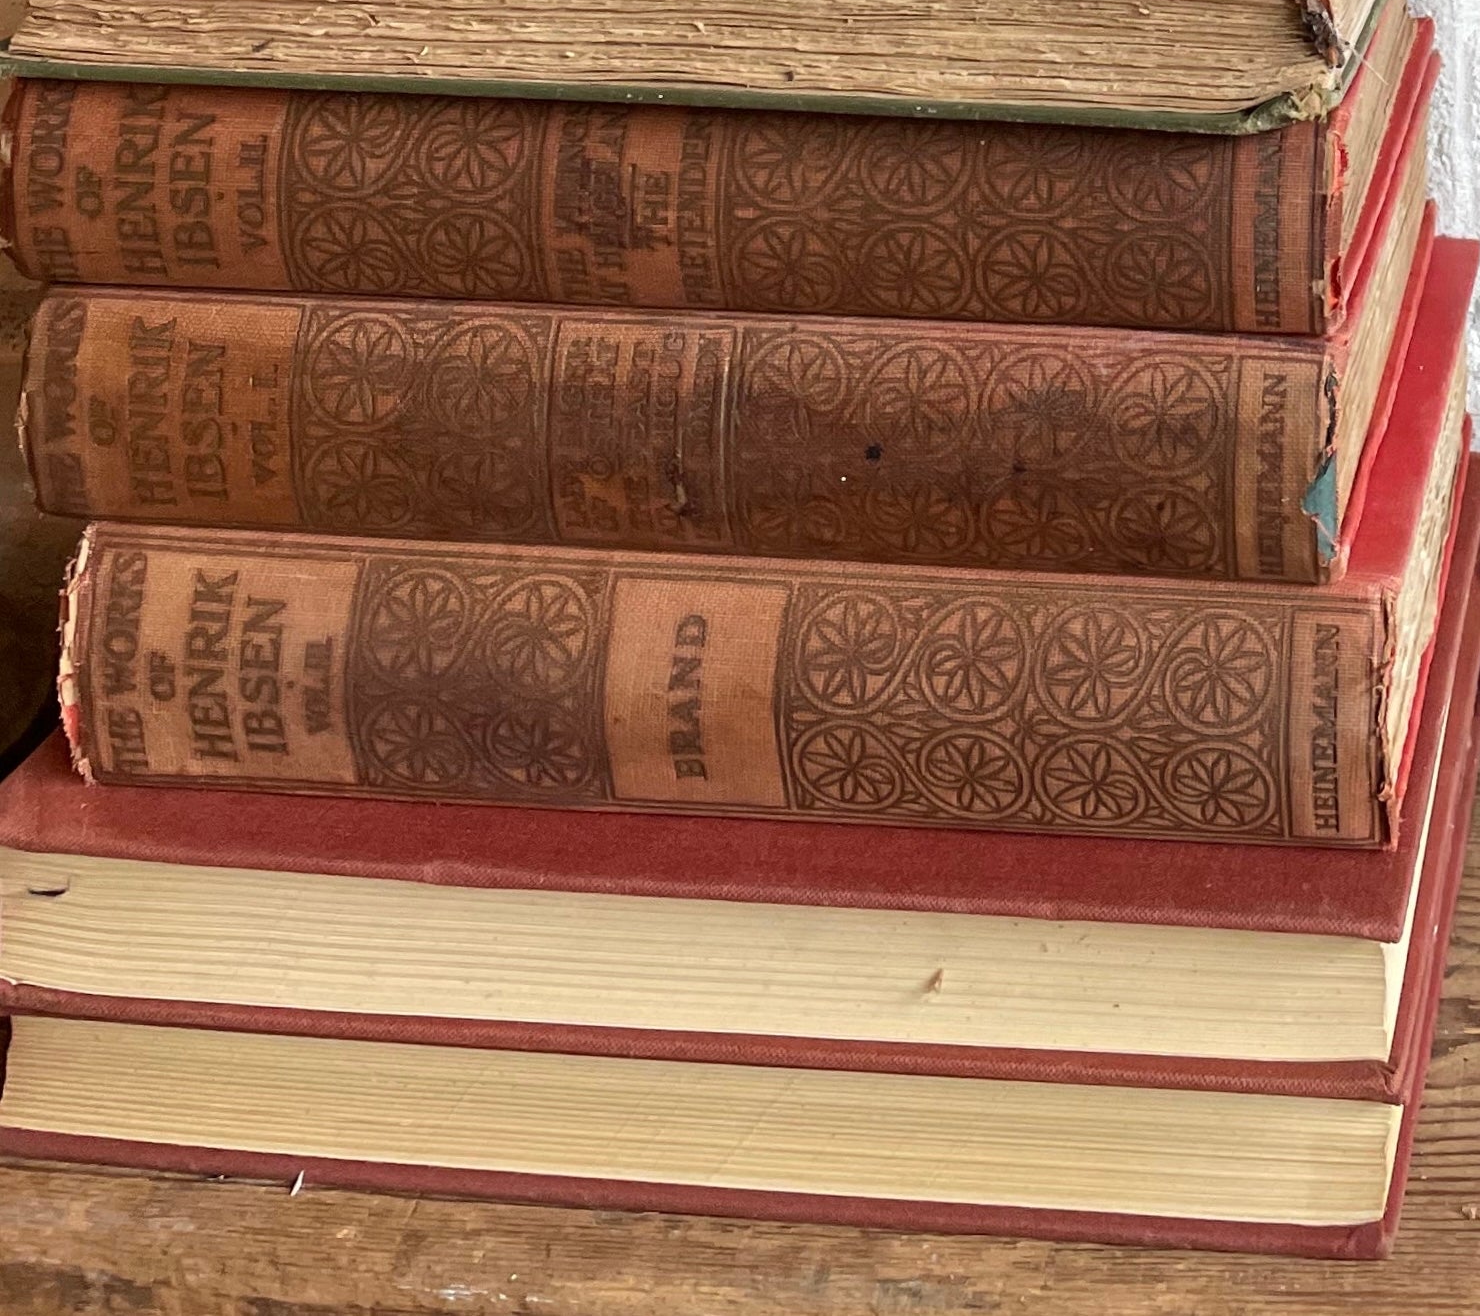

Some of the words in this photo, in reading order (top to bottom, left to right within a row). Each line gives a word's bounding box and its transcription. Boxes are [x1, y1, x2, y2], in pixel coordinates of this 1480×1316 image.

[76, 165, 104, 219] OF
[114, 83, 168, 278] HENRIK
[168, 110, 221, 270] IBSEN
[125, 315, 177, 507] HENRIK
[180, 338, 228, 502] IBSEN
[101, 551, 147, 697] WORKS
[148, 649, 176, 703] OF
[184, 567, 239, 763] HENRIK
[238, 594, 290, 756] IBSEN
[666, 614, 707, 781] BRAND
[106, 708, 149, 774] THE
[1311, 622, 1340, 833] HEINEMANN
